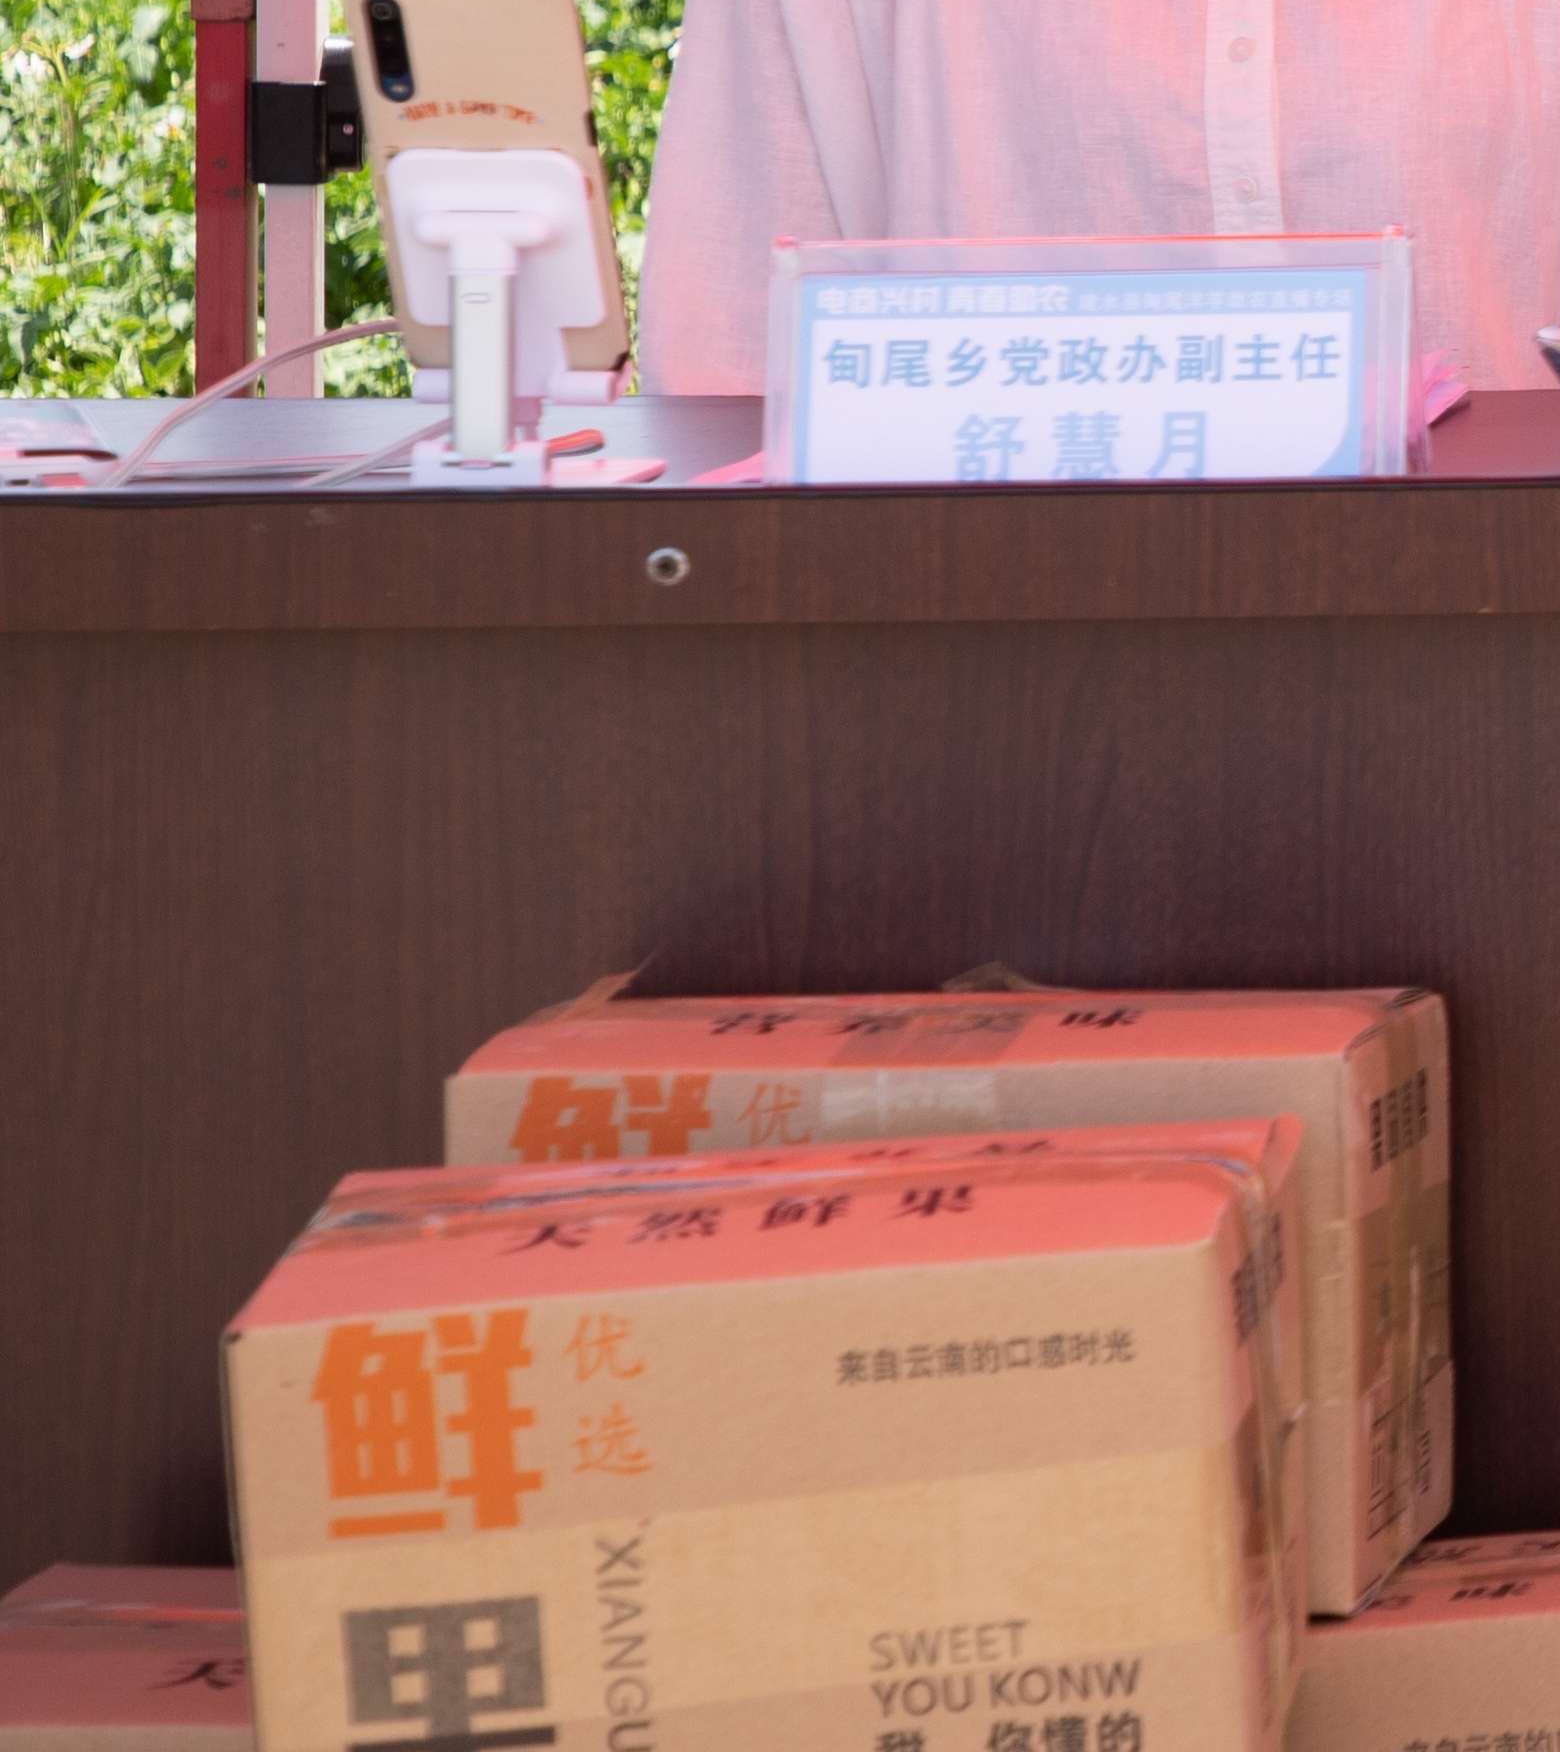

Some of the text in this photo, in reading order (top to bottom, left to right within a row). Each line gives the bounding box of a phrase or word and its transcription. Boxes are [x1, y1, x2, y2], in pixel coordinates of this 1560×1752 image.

[822, 332, 1343, 389] 甸尾乡党政办副主任
[953, 410, 1211, 480] 舒慧月
[500, 1183, 977, 1255] 天然鲜果
[836, 1328, 1136, 1386] 来自云南的口感时光
[564, 1311, 657, 1477] 优选
[868, 1619, 1028, 1673] SWEET
[871, 1658, 1144, 1719] YOU KONW
[875, 1711, 1145, 1752] 甜你懂的
